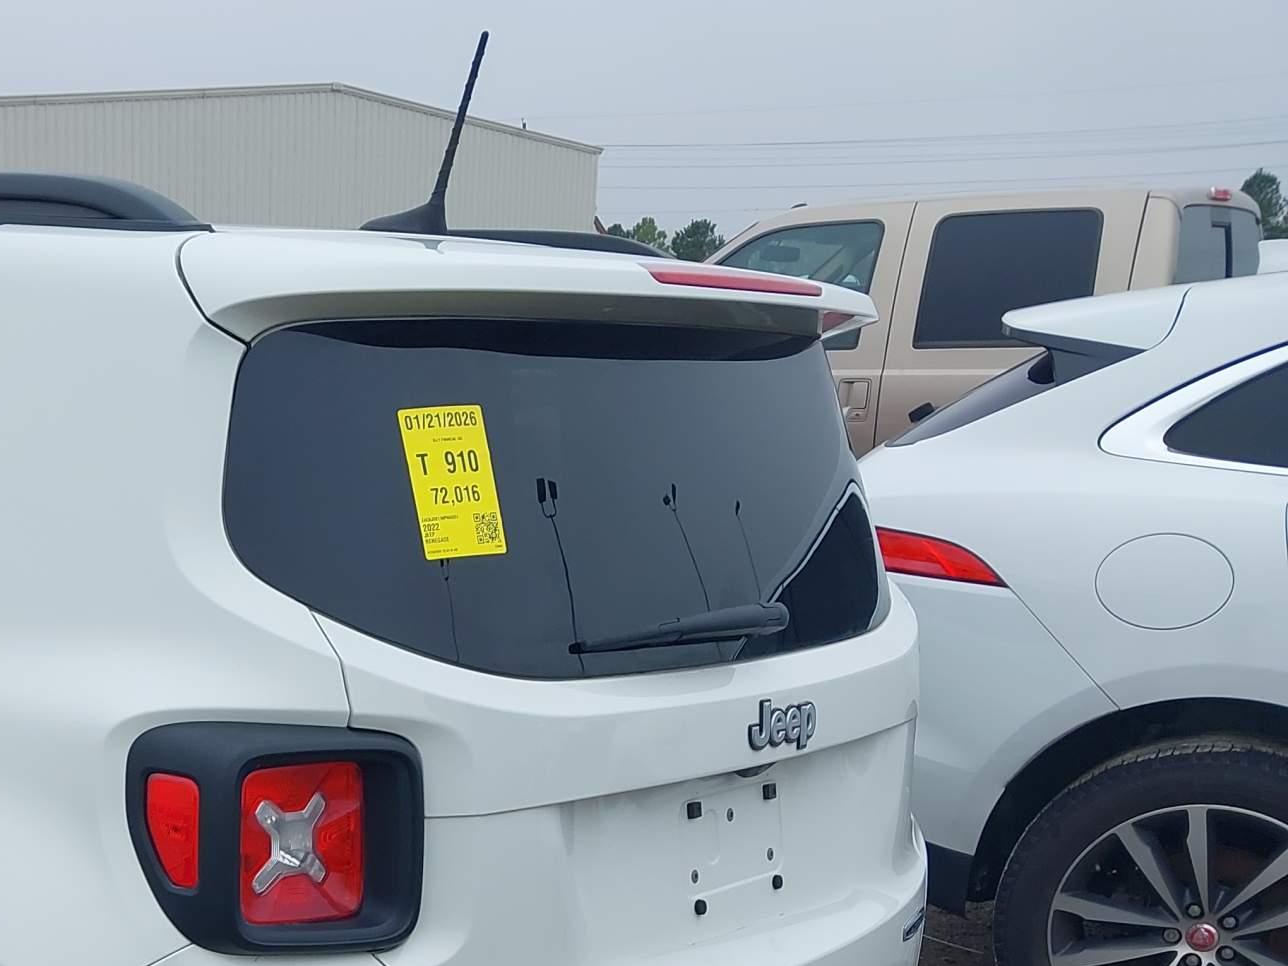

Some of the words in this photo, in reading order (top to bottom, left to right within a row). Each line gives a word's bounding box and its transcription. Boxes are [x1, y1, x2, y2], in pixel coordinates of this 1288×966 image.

[404, 411, 478, 431] 01/21/2026
[415, 453, 428, 476] T
[444, 449, 480, 474] 910
[430, 484, 481, 506] 72,016
[422, 523, 441, 533] 2022
[748, 699, 817, 751] Jeep
